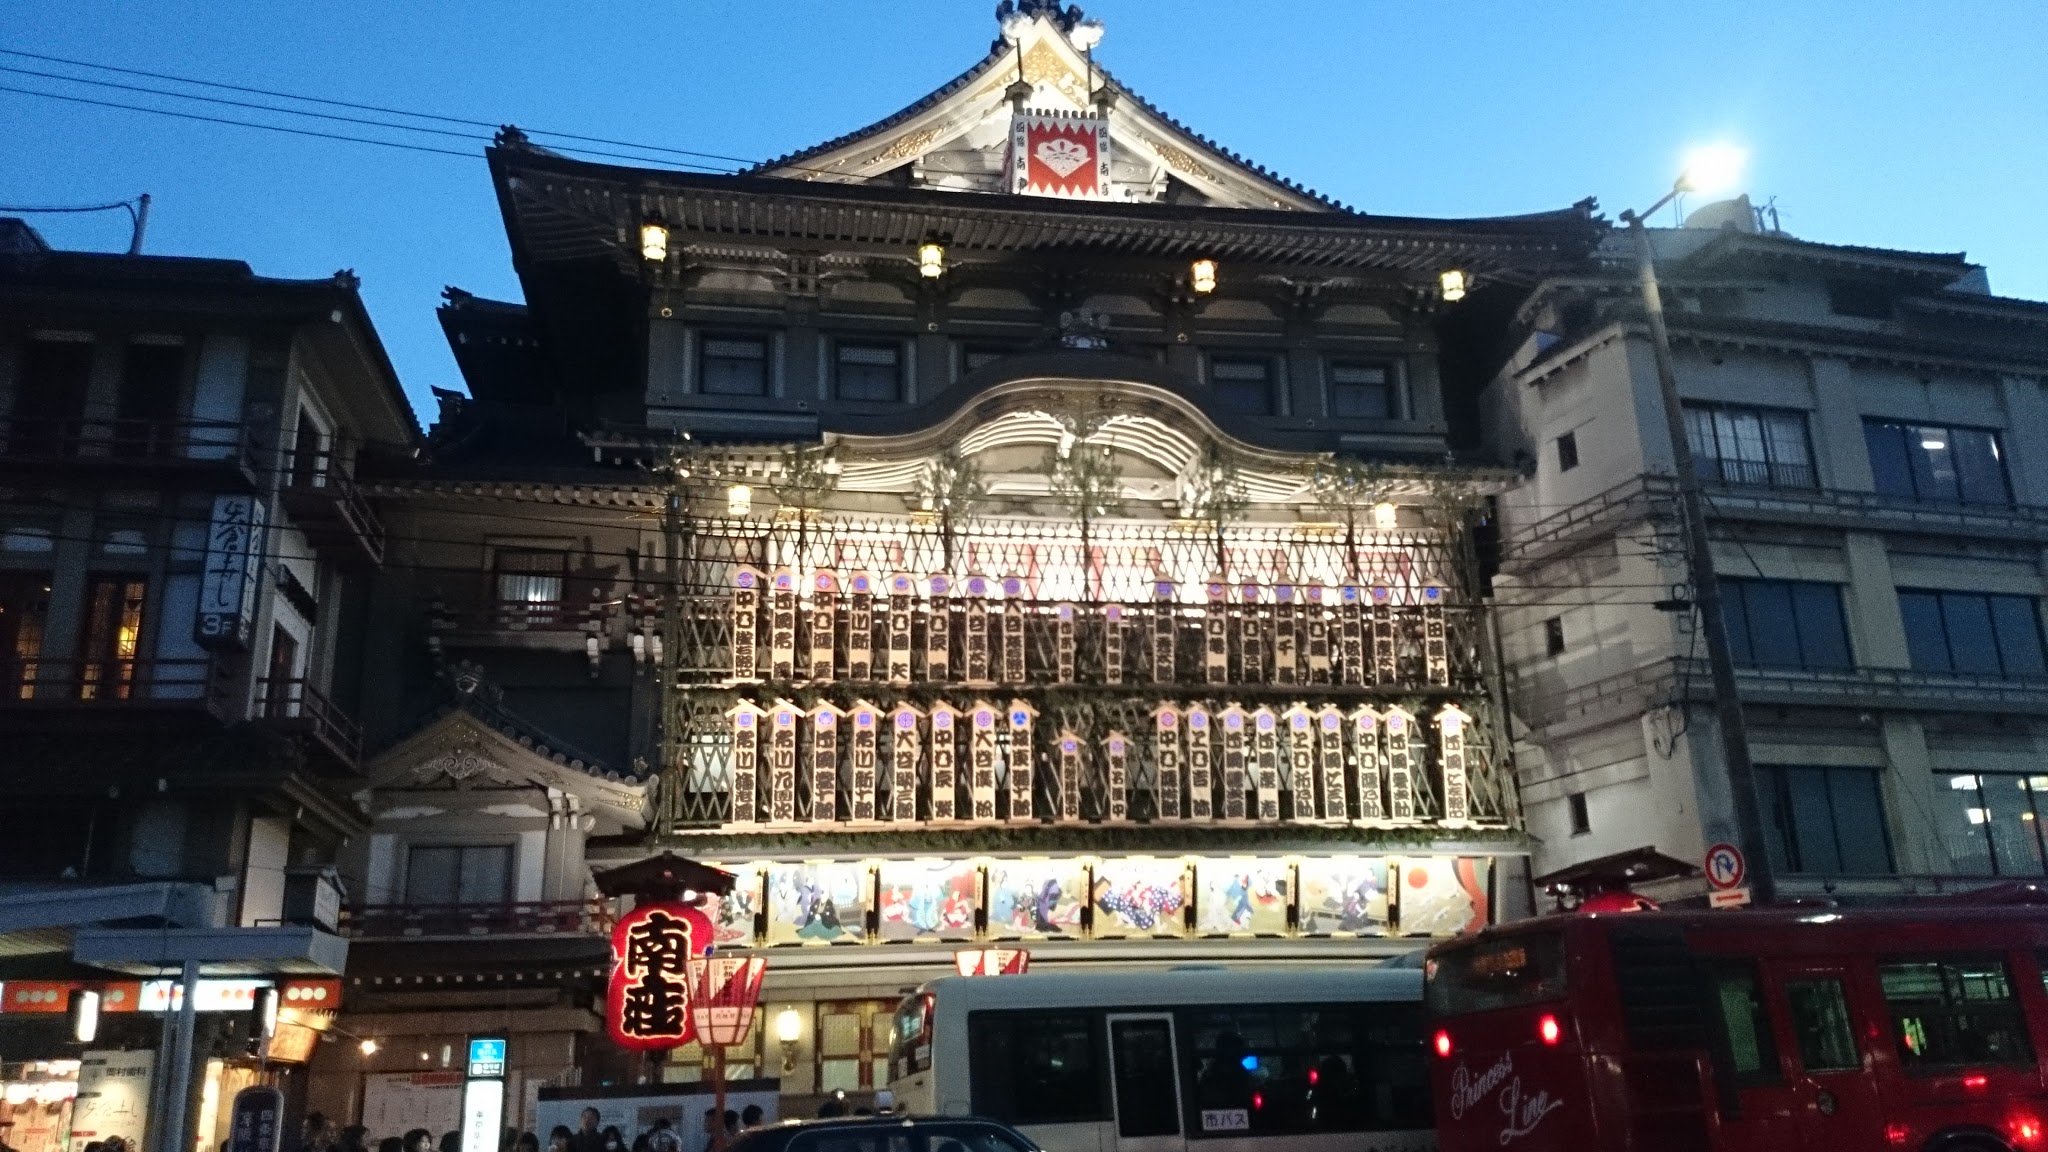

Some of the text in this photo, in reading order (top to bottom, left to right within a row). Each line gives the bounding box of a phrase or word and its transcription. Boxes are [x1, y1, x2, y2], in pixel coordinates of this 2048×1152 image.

[202, 613, 233, 636] 3F
[622, 911, 691, 1038] 南座
[1204, 1112, 1247, 1129] 市バス
[1452, 1050, 1563, 1146] Princess Line
